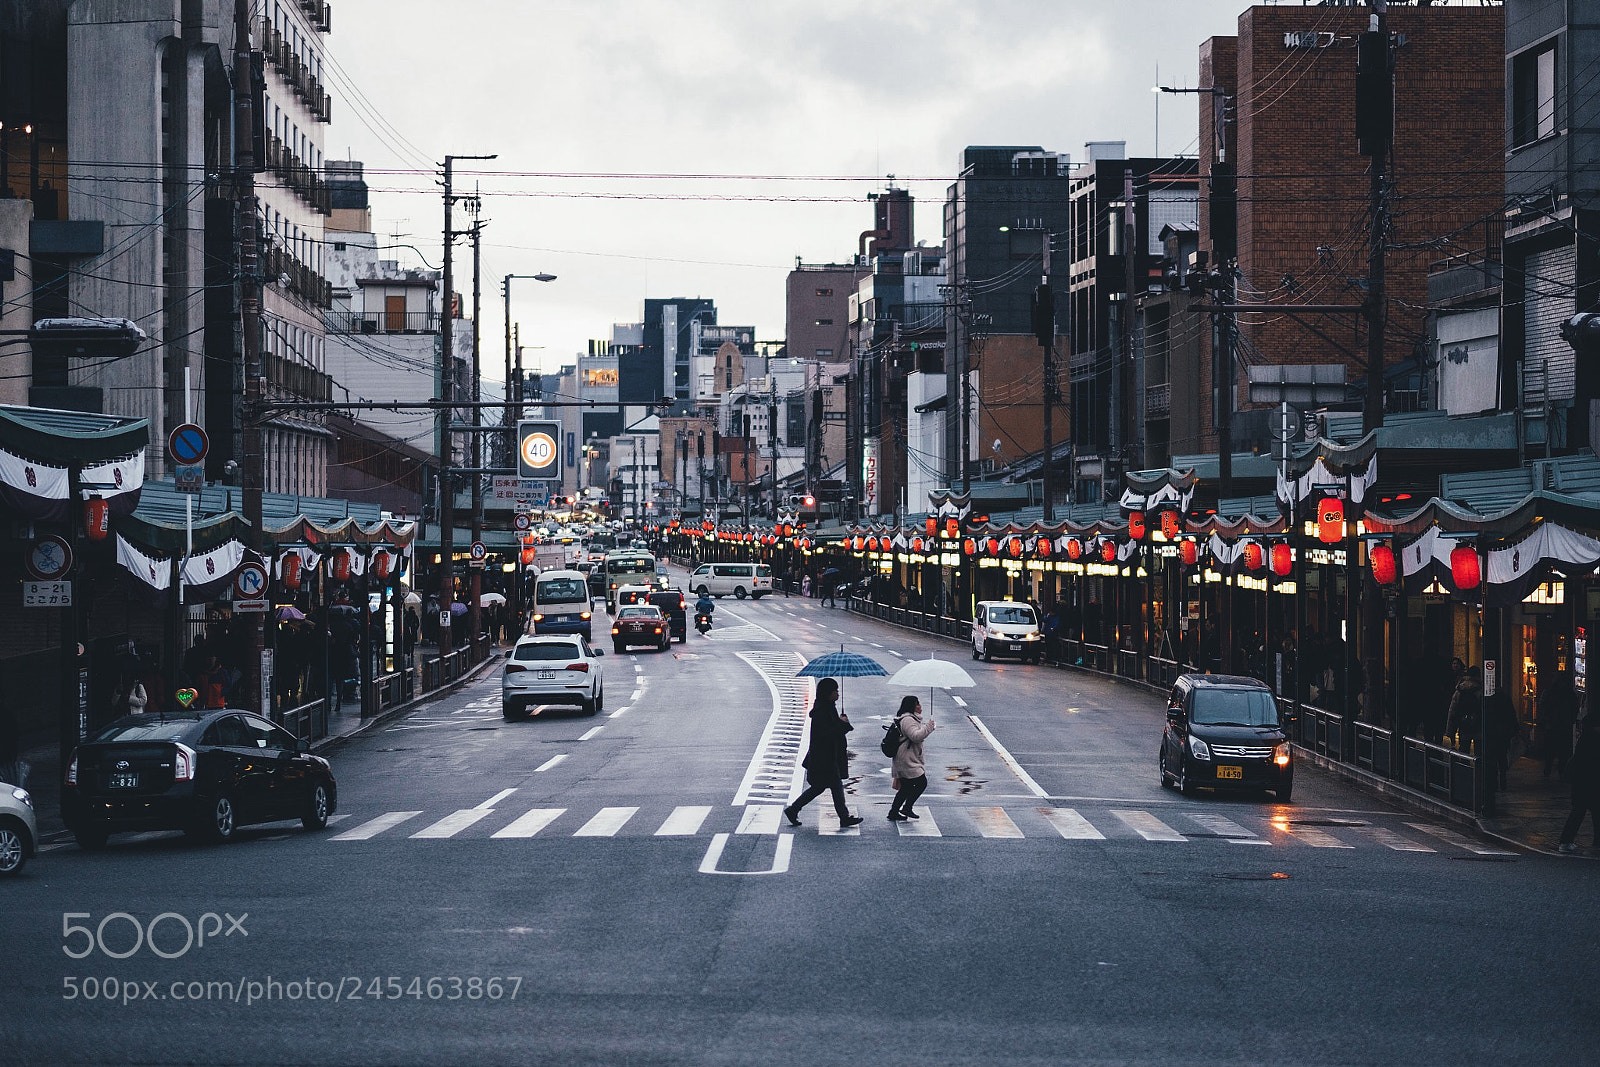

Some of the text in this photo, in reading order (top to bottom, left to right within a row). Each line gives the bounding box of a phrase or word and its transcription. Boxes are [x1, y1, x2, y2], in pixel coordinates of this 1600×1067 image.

[919, 341, 946, 350] yasaka
[530, 443, 548, 457] 40
[26, 594, 70, 605] ここから
